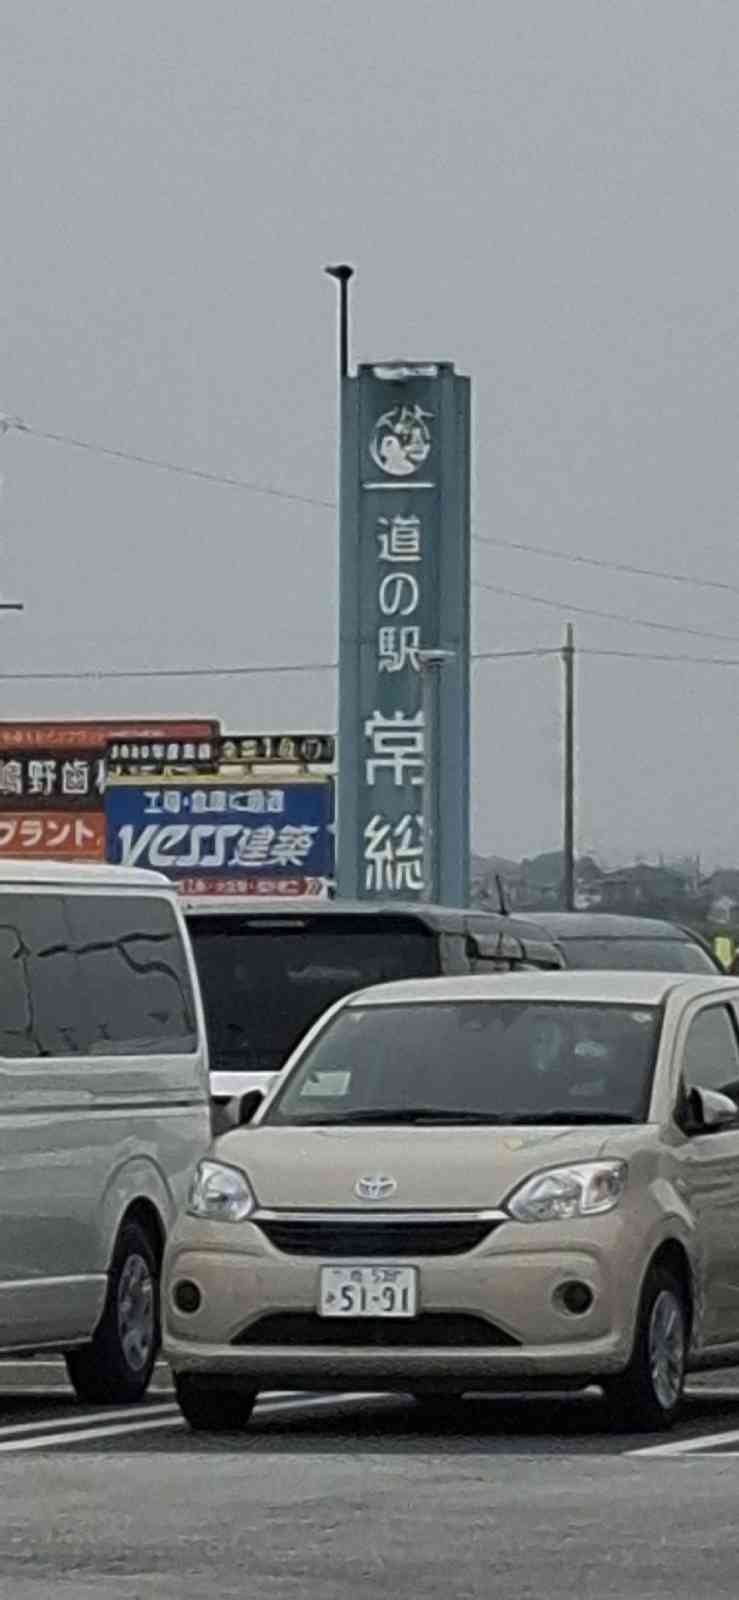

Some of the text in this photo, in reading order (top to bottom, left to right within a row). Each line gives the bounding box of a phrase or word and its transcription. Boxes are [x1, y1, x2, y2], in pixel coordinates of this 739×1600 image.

[364, 514, 426, 890] 道の駅 常総
[340, 1285, 409, 1312] 51-91
